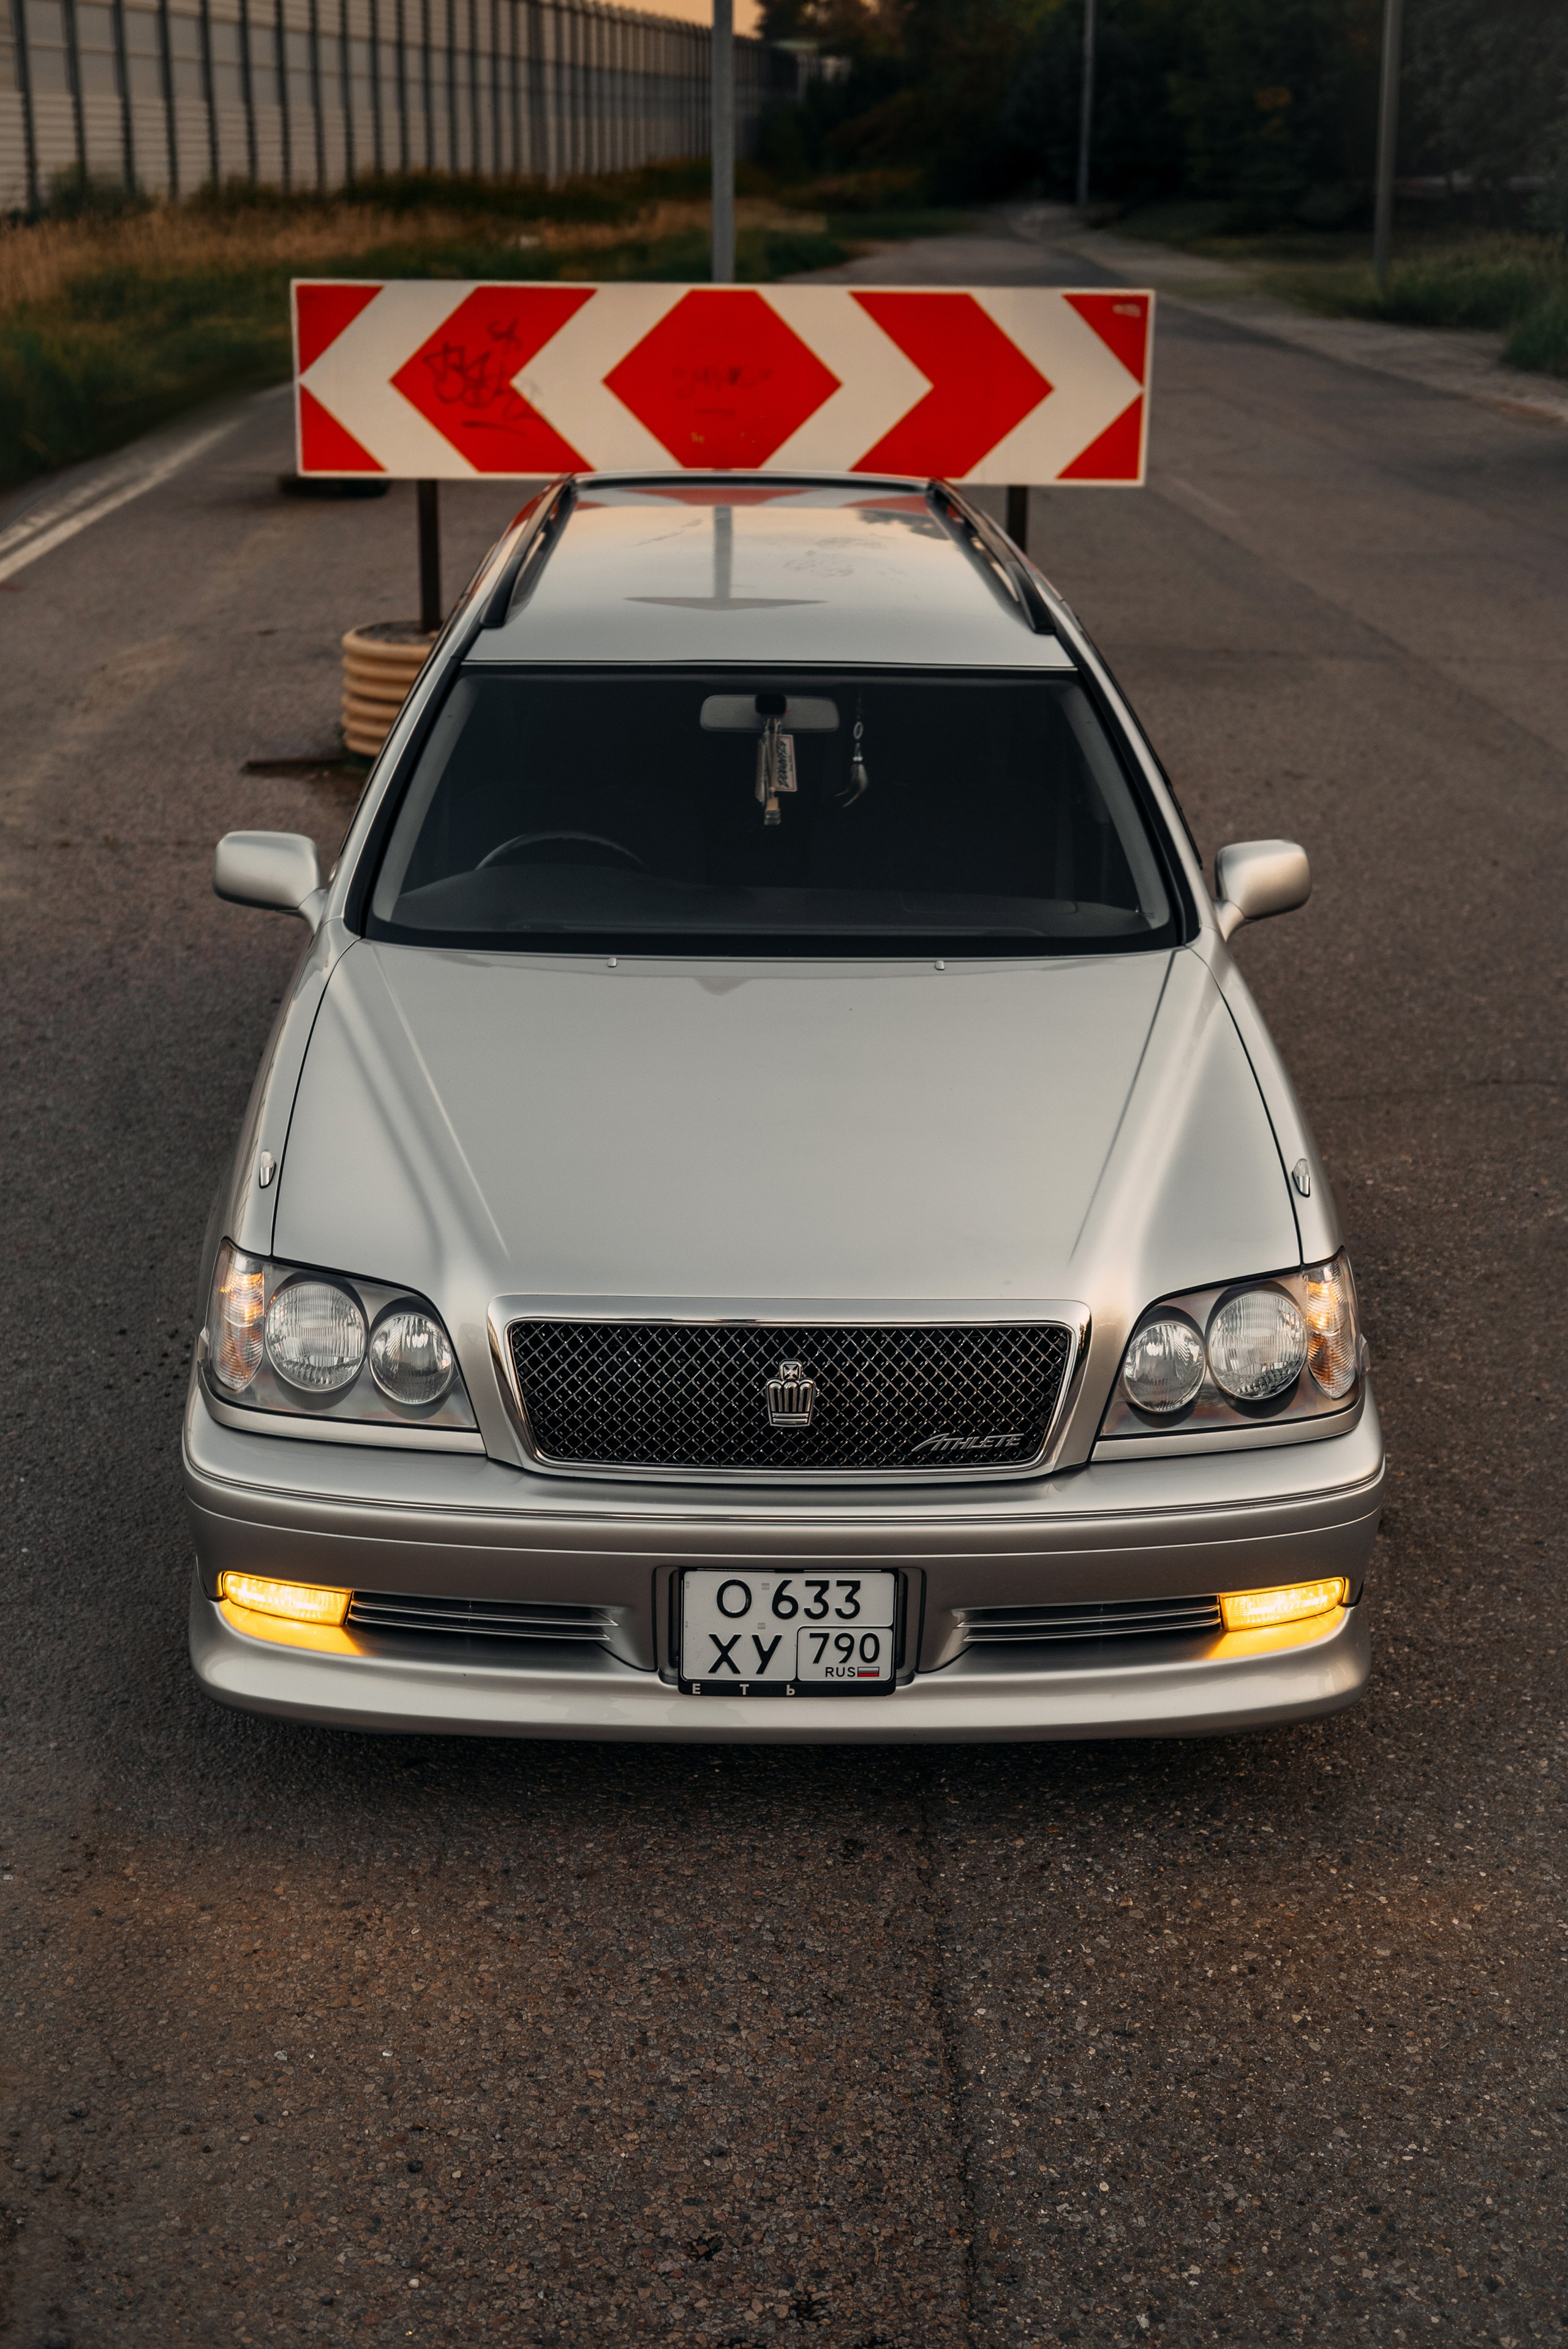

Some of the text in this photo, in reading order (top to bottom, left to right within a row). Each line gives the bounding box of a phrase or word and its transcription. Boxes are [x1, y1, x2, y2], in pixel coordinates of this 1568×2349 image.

[911, 1433, 1024, 1452] ATHLETE
[771, 1580, 861, 1619] 633
[809, 1632, 880, 1664] 790
[825, 1667, 856, 1678] RUS
